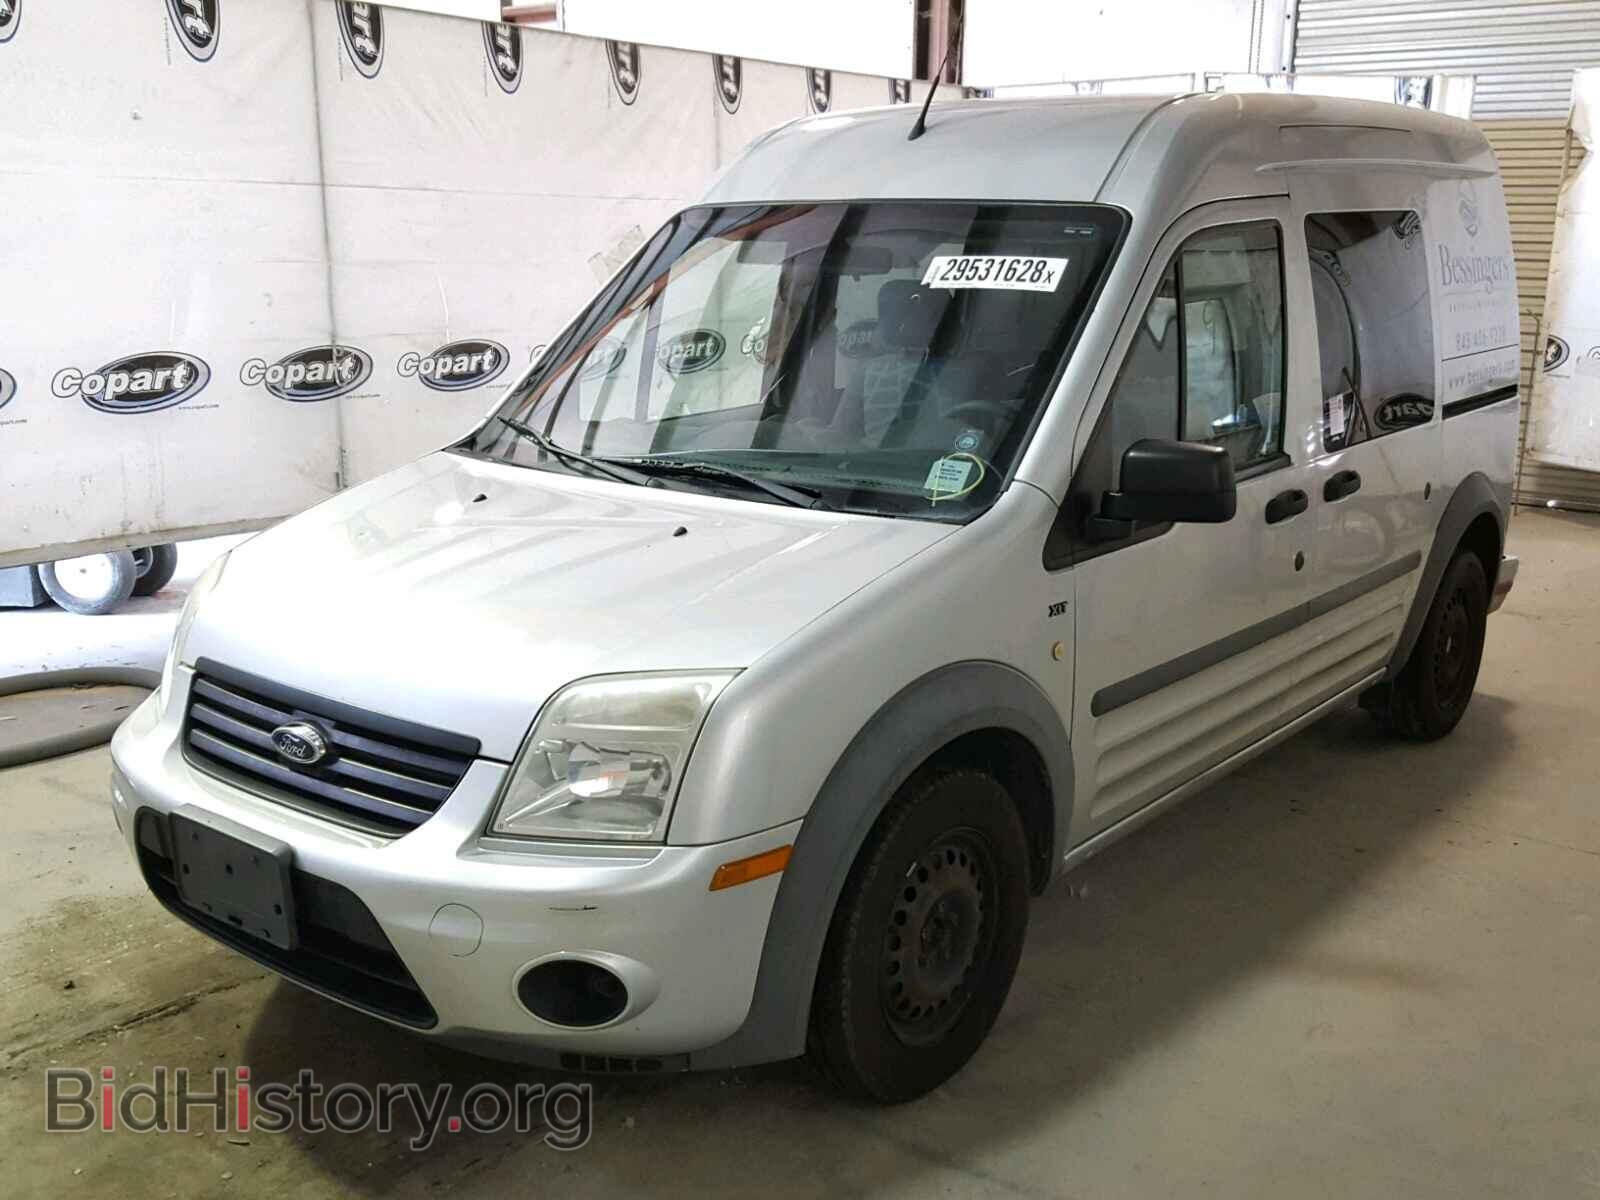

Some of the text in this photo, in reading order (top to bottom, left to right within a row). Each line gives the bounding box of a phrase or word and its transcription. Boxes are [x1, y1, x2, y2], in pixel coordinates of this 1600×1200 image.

[51, 359, 190, 401] Copart
[240, 352, 357, 389] Copart
[397, 345, 497, 380] Copart
